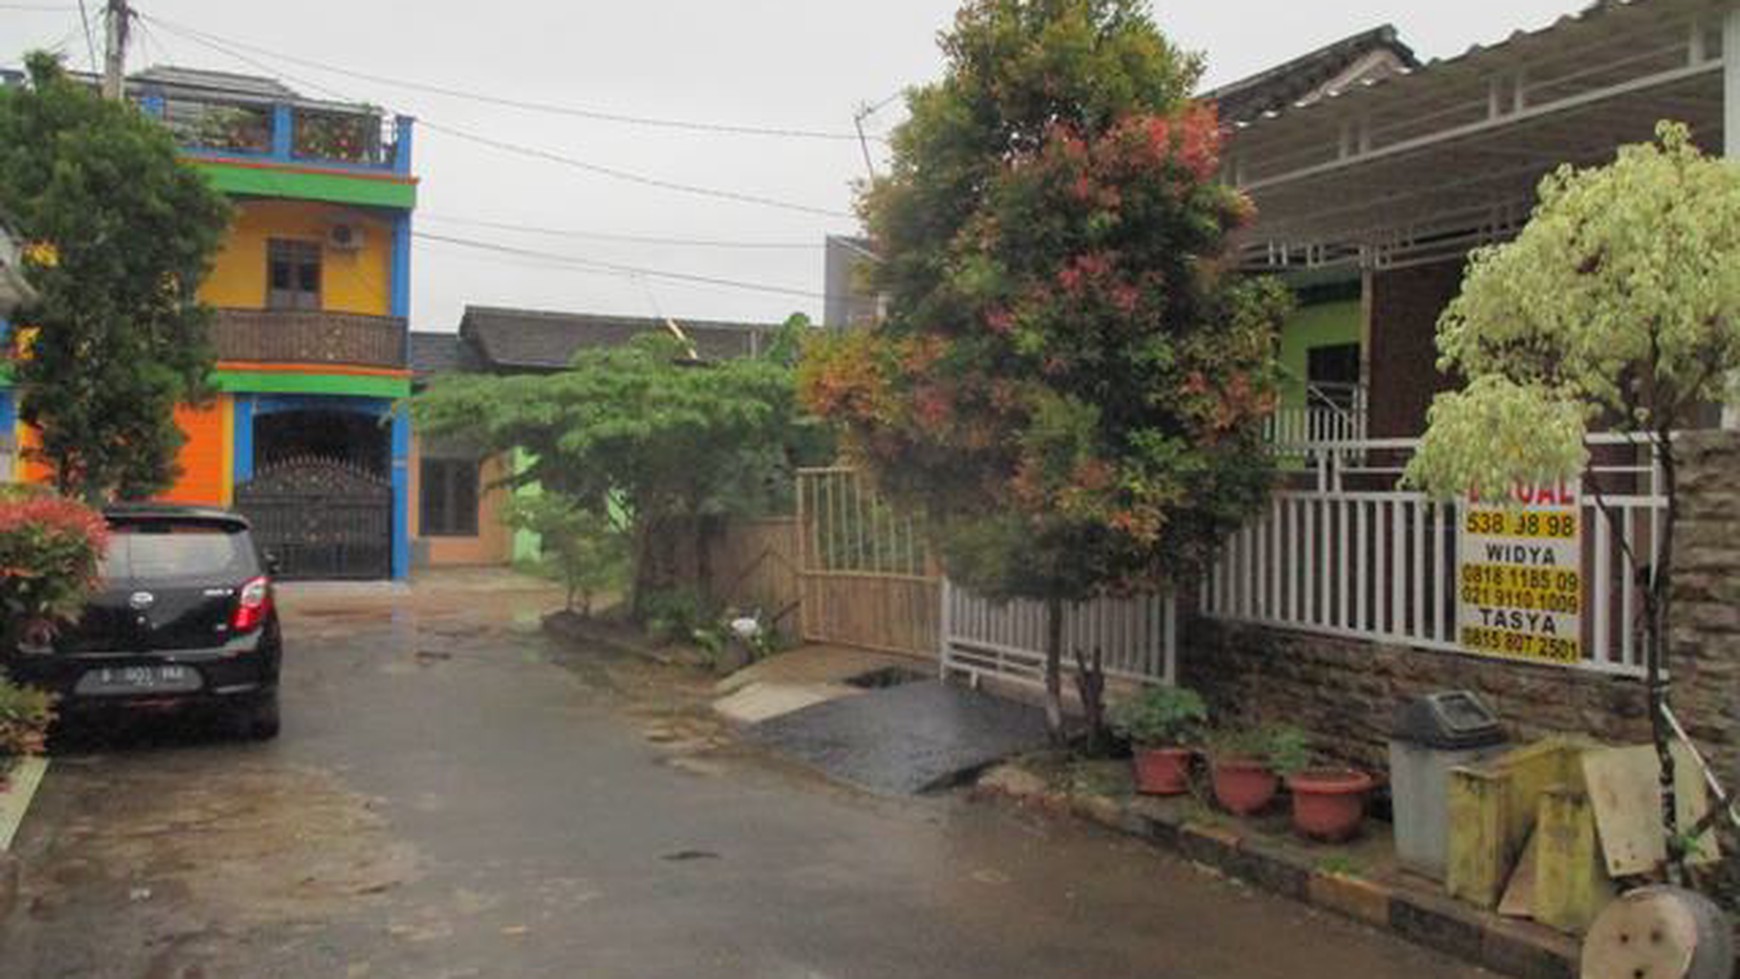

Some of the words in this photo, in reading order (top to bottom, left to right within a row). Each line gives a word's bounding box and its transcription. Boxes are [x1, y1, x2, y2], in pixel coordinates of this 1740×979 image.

[1468, 478, 1575, 504] UAL
[1466, 511, 1504, 534] 538
[1548, 515, 1574, 537] 98
[1486, 544, 1556, 565] WIDYA
[1556, 571, 1578, 593] 09
[1462, 585, 1488, 604] 021
[1479, 608, 1556, 634] TASYA
